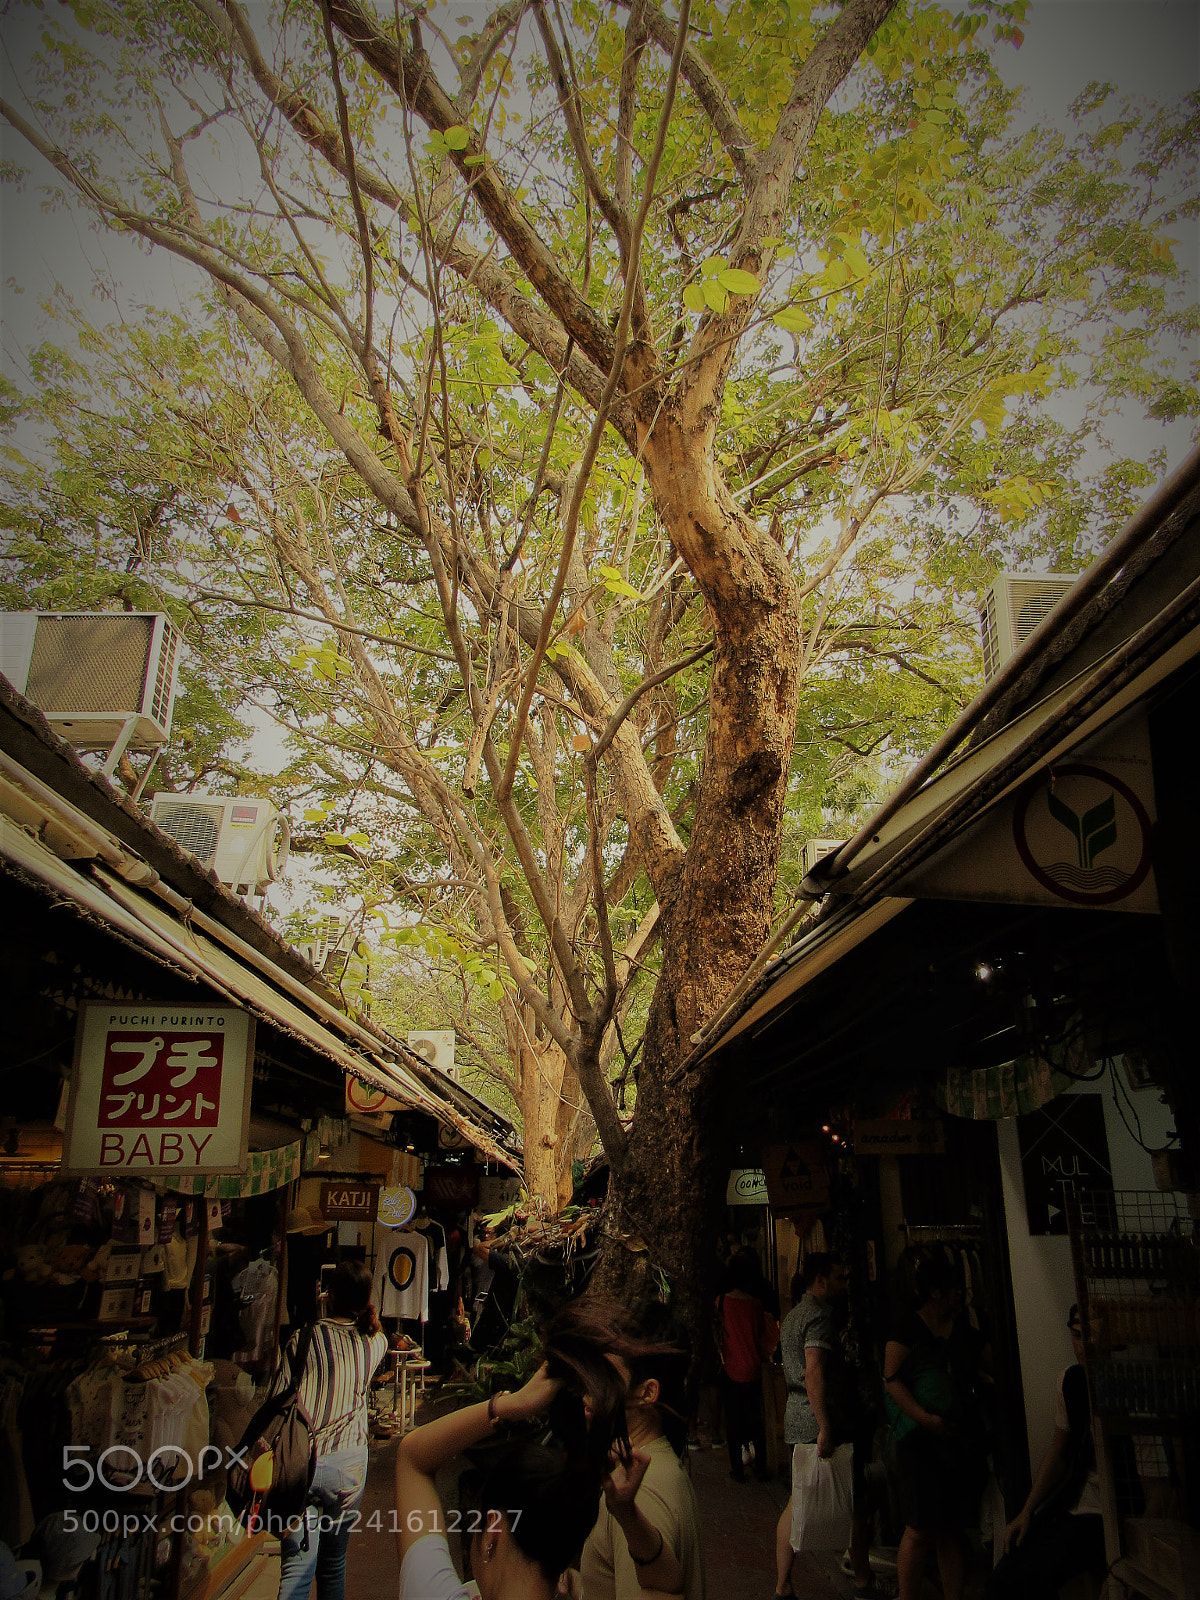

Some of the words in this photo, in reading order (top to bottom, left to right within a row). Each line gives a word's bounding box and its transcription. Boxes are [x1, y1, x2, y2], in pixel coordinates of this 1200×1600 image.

[109, 1015, 155, 1025] PUCHI
[161, 1016, 225, 1026] PURINTO
[110, 1036, 218, 1088] プチ
[106, 1091, 216, 1120] プリント
[99, 1133, 213, 1166] BABY
[327, 1190, 371, 1206] KATJI
